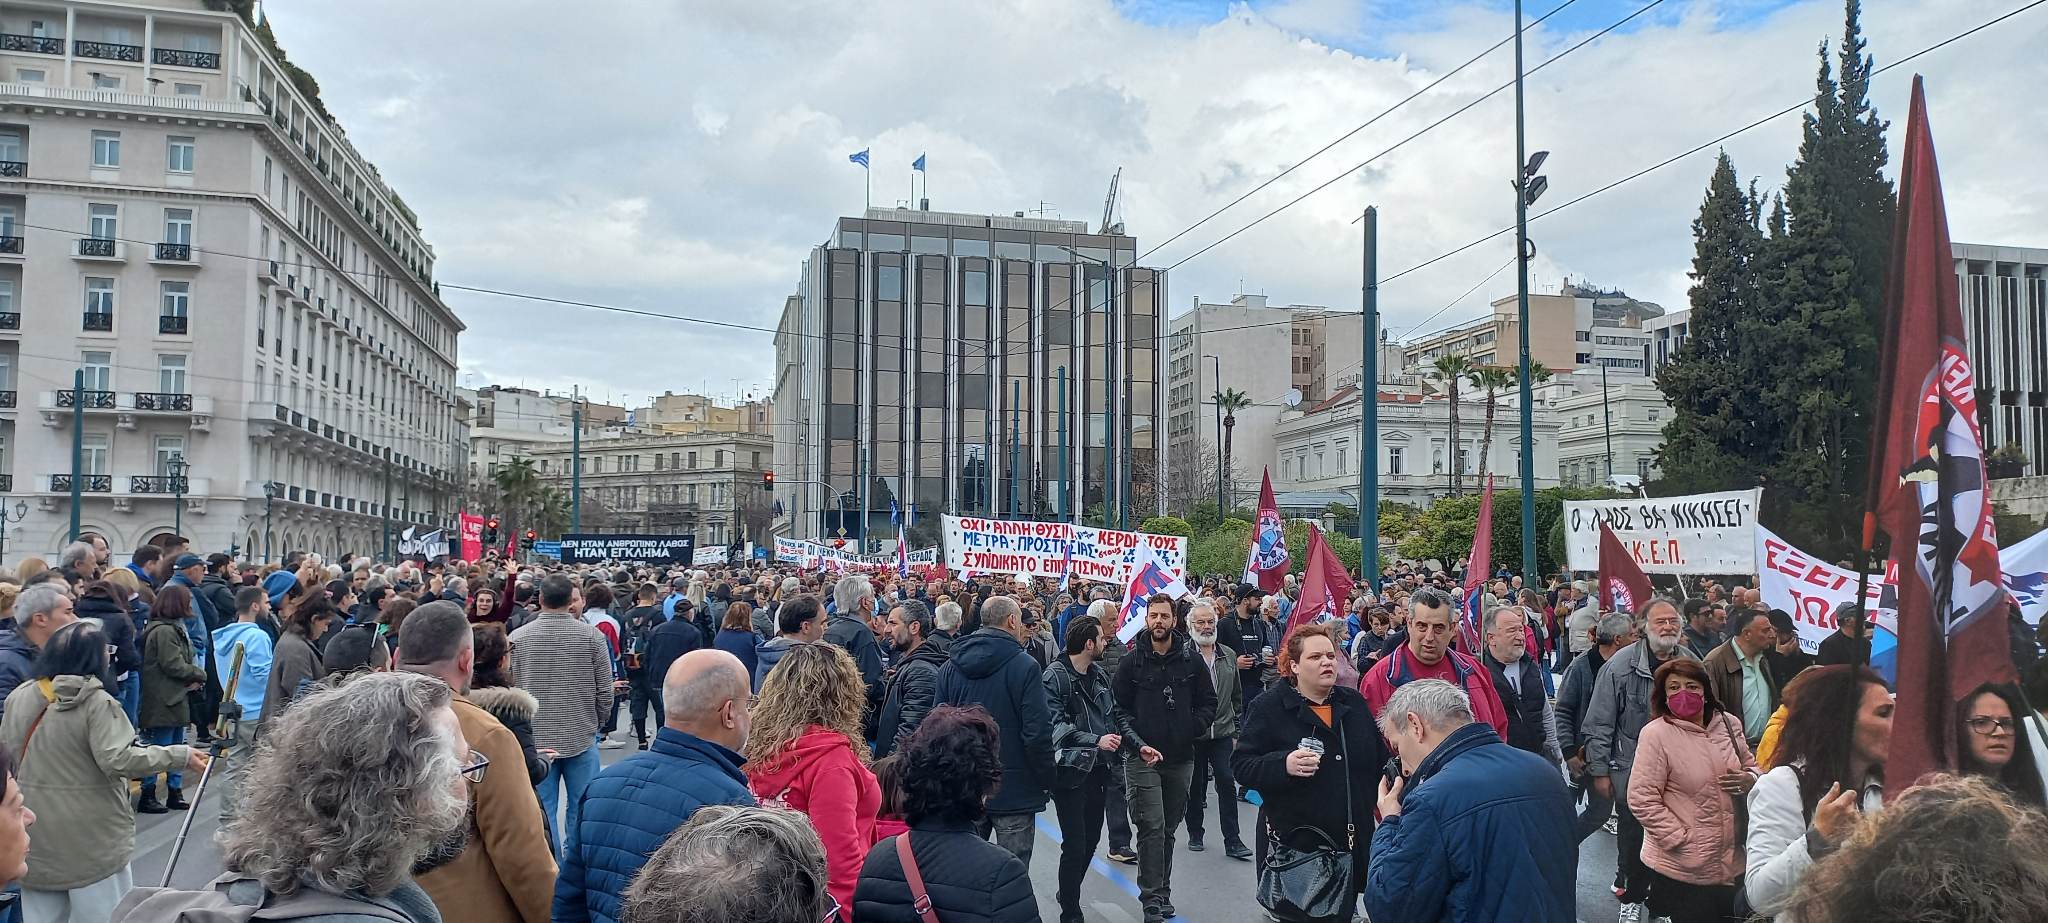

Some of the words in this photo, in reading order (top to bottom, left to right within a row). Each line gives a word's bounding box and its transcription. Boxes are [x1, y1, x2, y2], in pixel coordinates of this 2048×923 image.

[1571, 508, 1581, 532] Ο
[1638, 504, 1666, 529] ΘΑ
[1670, 498, 1743, 528] ΝΙΚΗΣΕΙ
[960, 518, 985, 532] ΟΧΙ
[1147, 535, 1178, 551] ΤΟΥΣ
[963, 531, 1008, 548] ΜΕΤΡΑ
[560, 540, 578, 548] ΔΕΝ
[580, 540, 605, 548] ΗΤΑΝ
[658, 539, 689, 548] ΛΑΘΟΣ
[574, 548, 607, 558] ΗΤΑΝ
[610, 547, 670, 558] ΕΓΚΛΗΜΑ
[907, 549, 933, 563] ΚΕΡΔΟΣ
[962, 548, 1037, 573] ΣΥΝΔΙΚΑΤΟ
[1043, 559, 1115, 579] ΕΠΙΤΙΣΜΟΥ
